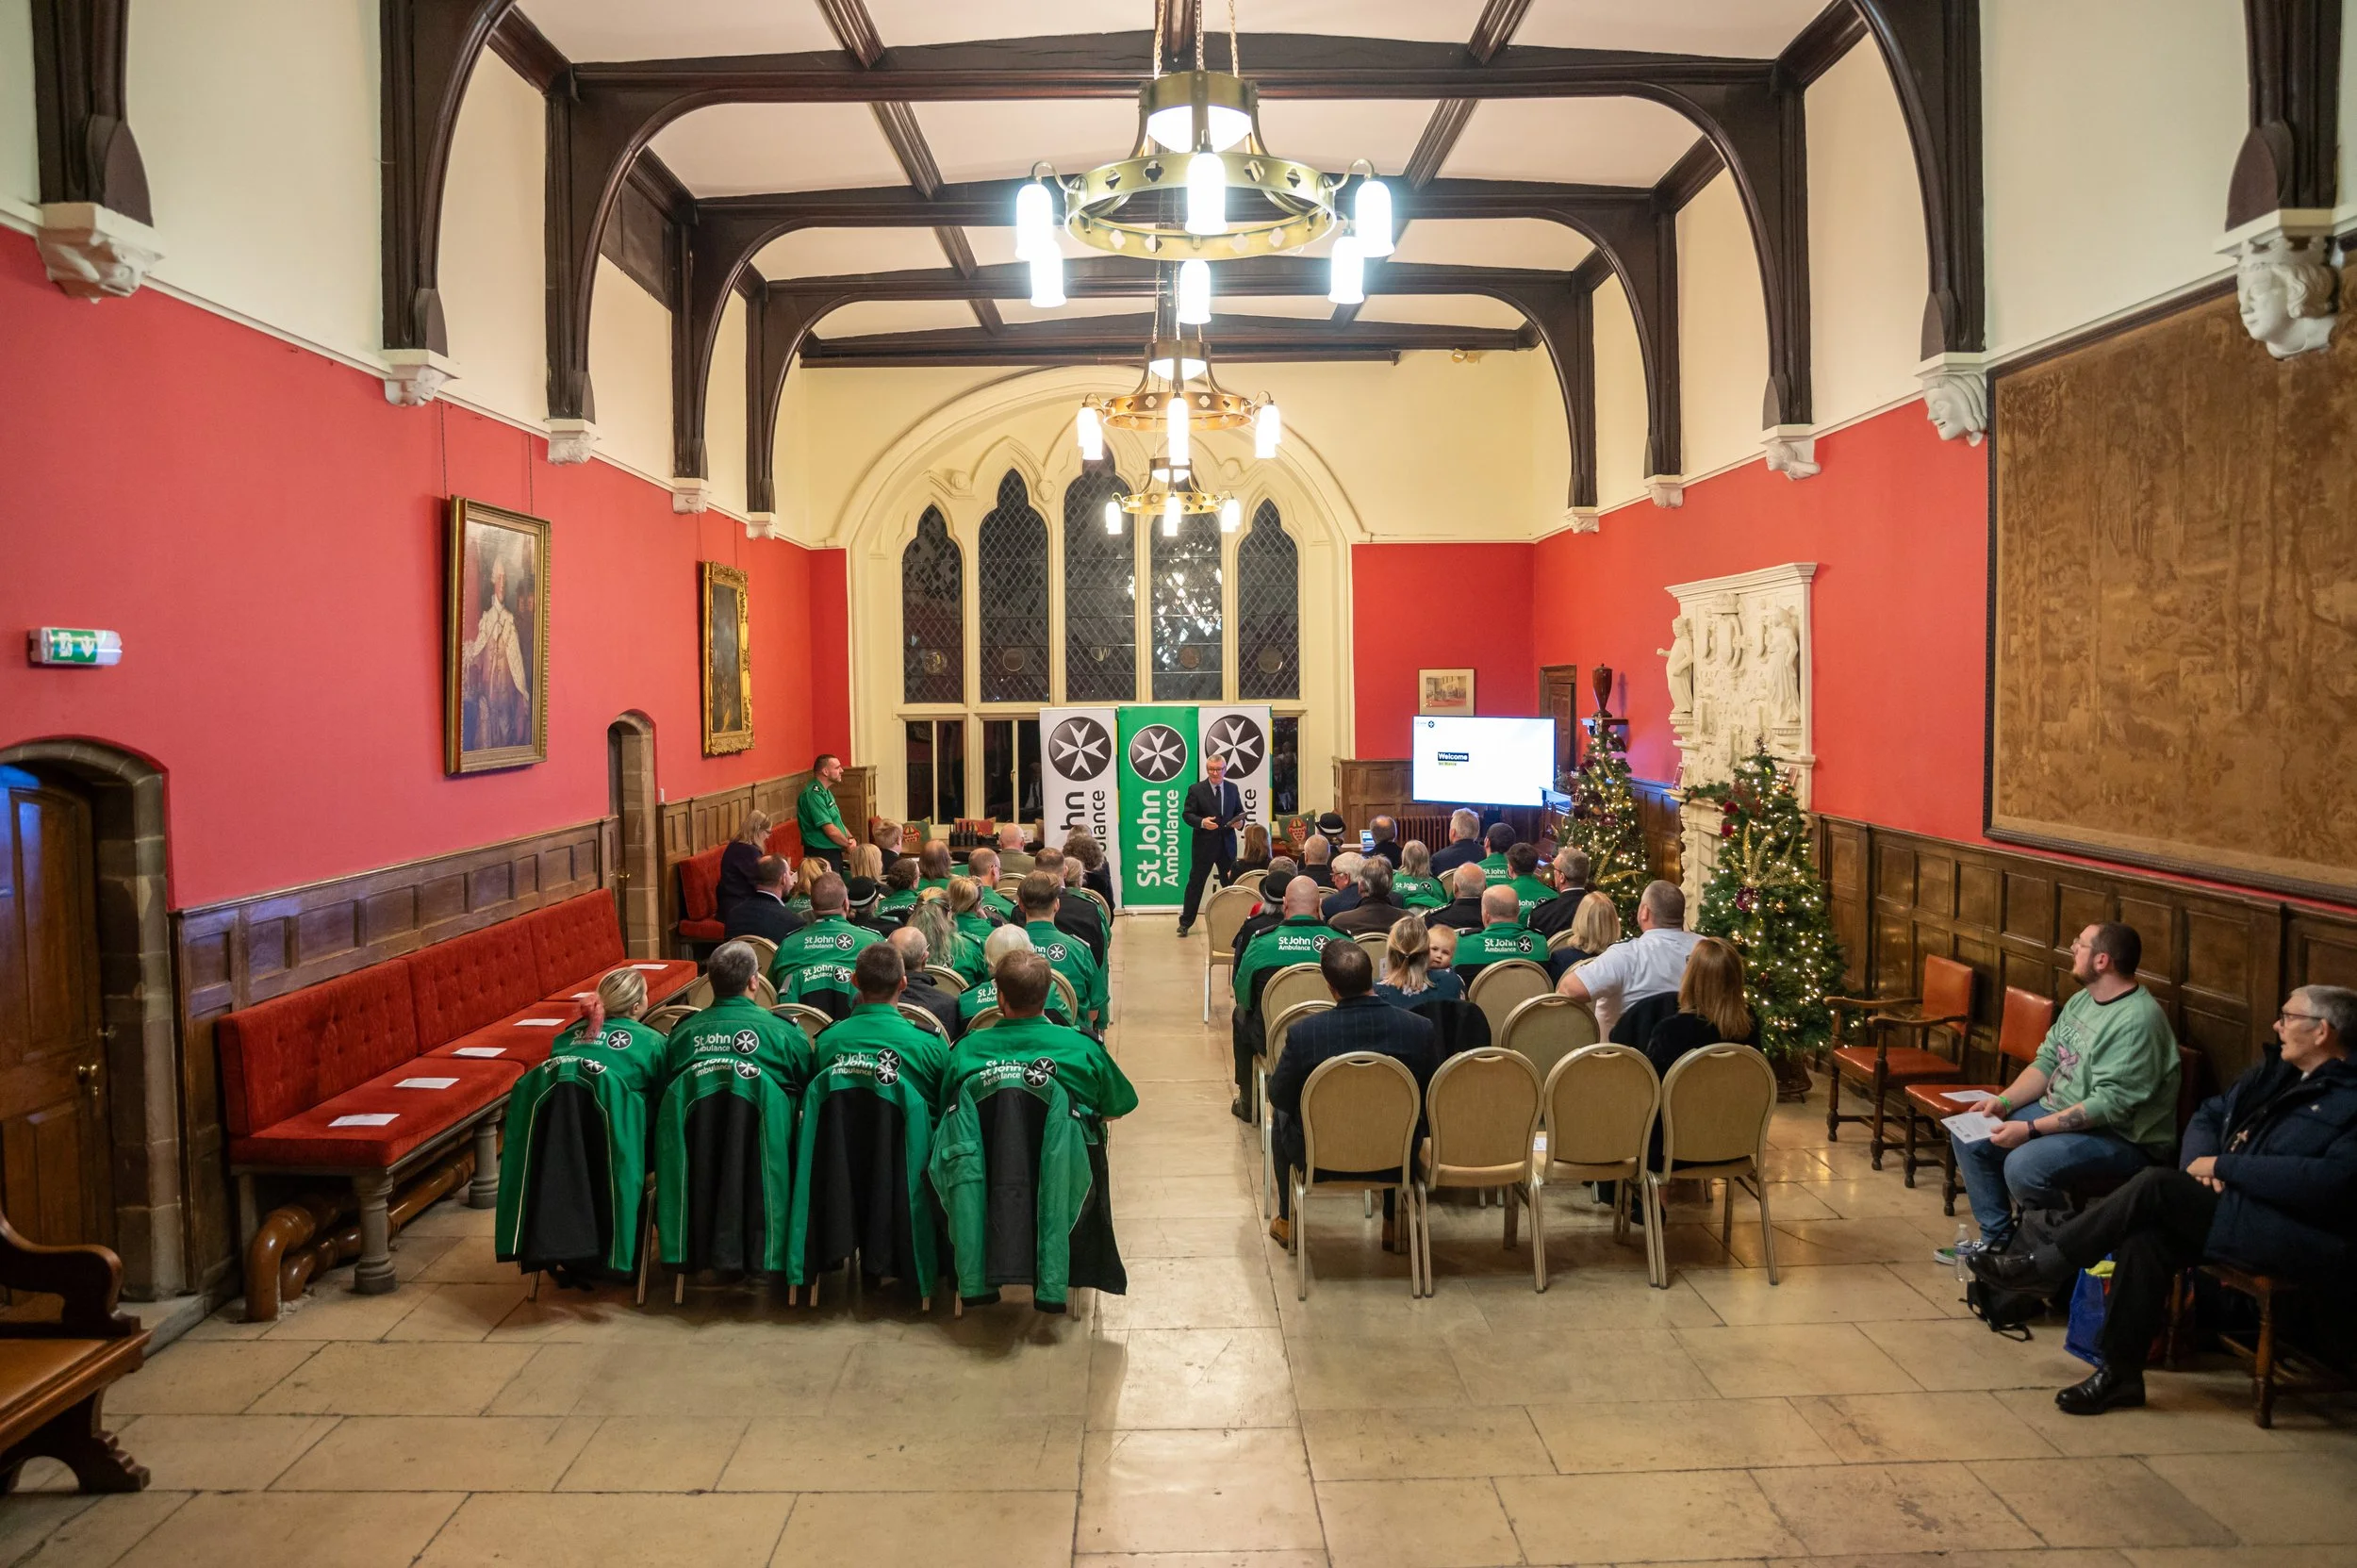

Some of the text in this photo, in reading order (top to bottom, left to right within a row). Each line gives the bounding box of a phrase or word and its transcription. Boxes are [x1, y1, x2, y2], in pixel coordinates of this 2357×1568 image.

[1438, 752, 1468, 761] Welcome
[1060, 791, 1085, 831] hn
[1092, 789, 1107, 852] ulance
[1136, 789, 1161, 887] St John
[1162, 789, 1178, 887] Ambulance
[814, 934, 834, 944] John
[1278, 936, 1310, 945] St John
[1484, 938, 1517, 947] St John
[802, 964, 833, 977] St John
[977, 986, 997, 998] St Jo
[977, 995, 997, 1004] Ambul
[693, 1035, 704, 1048] St
[831, 1066, 873, 1077] Ambulance
[980, 1067, 993, 1080] St
